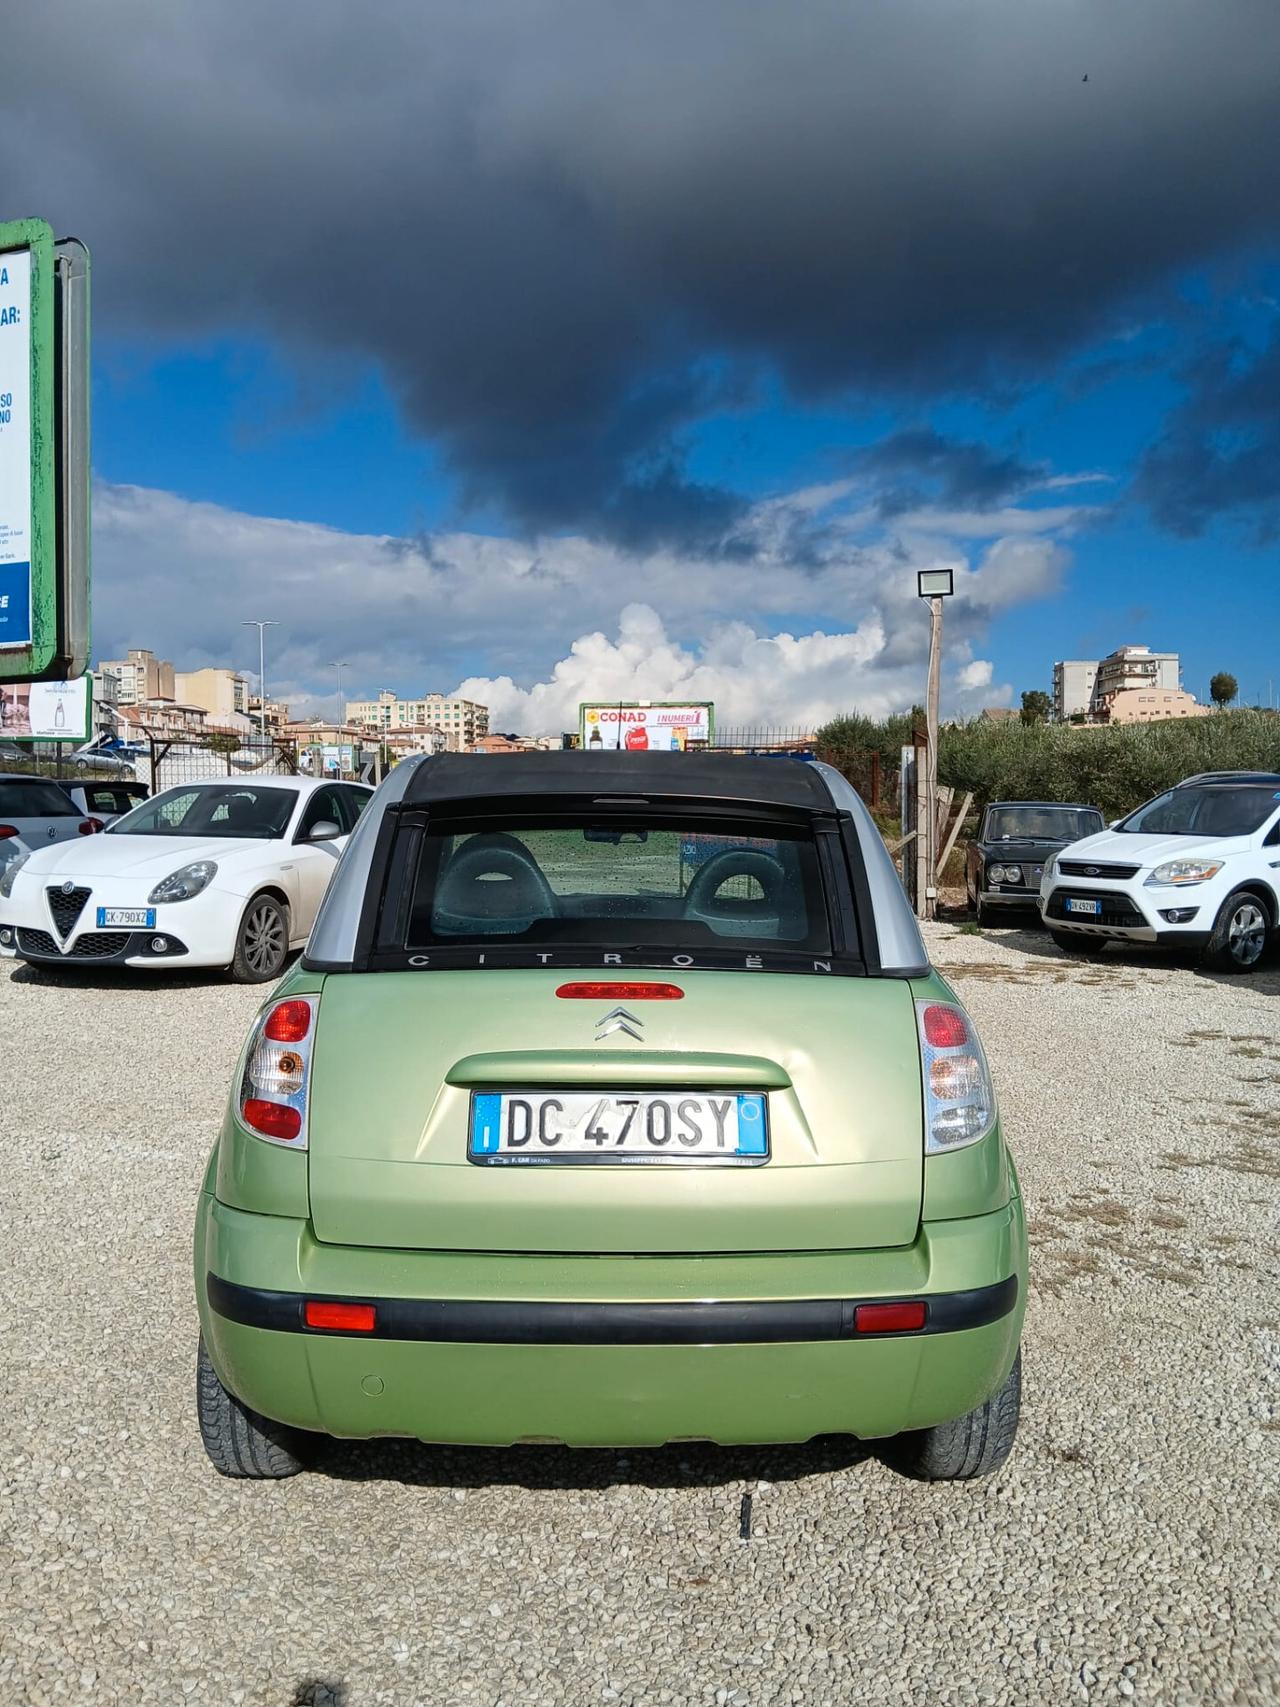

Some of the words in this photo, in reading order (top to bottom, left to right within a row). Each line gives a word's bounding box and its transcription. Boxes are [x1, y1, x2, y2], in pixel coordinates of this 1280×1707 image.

[600, 712, 647, 722] CONAD
[661, 714, 695, 722] NUMERI
[408, 953, 831, 972] CITROËN
[507, 1099, 564, 1148] DC
[584, 1099, 732, 1148] 470SY
